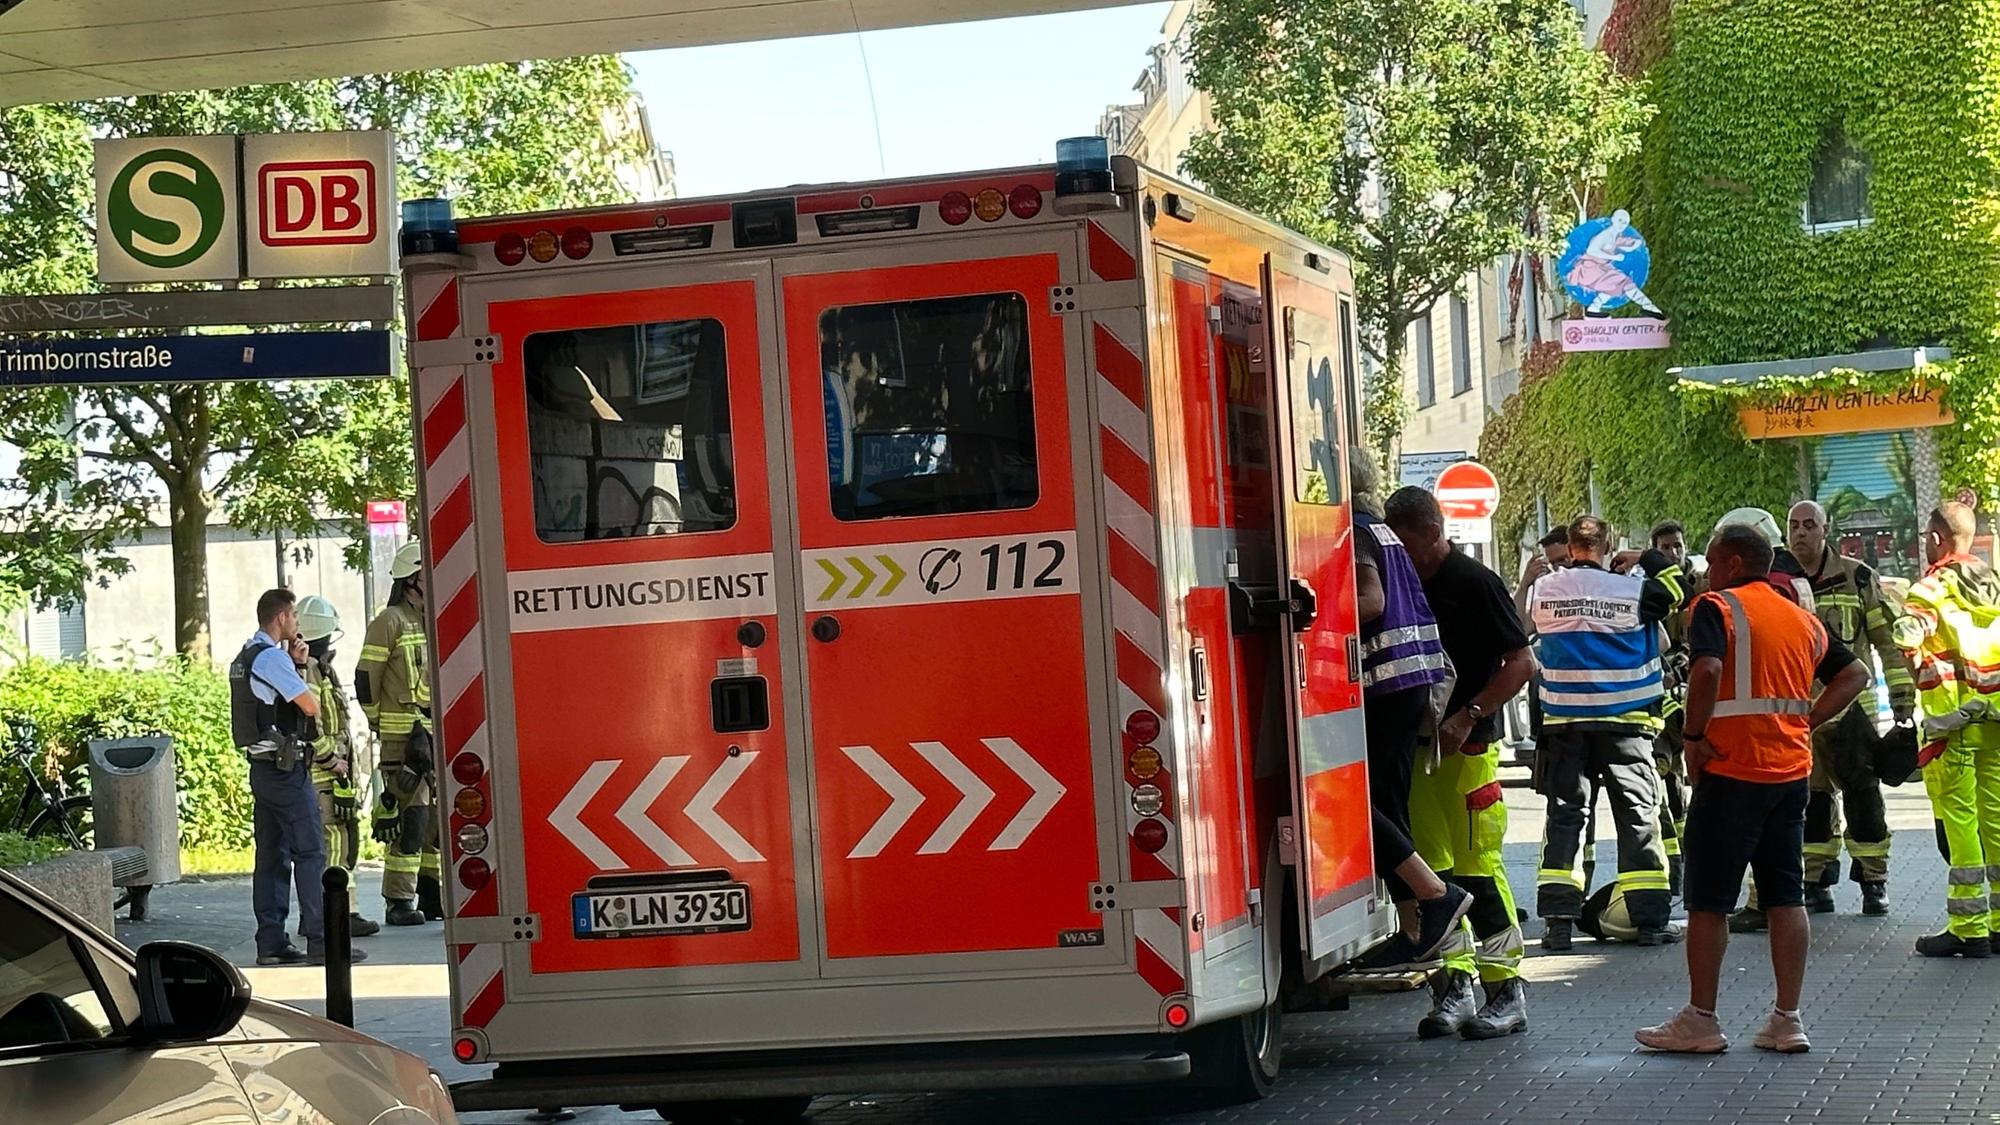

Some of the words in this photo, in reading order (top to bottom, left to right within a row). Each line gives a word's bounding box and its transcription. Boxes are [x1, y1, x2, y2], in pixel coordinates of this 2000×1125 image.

[128, 160, 203, 257] S
[274, 175, 362, 232] DB
[1622, 324, 1655, 335] CENTER
[980, 539, 1066, 592] 112
[513, 571, 769, 614] RETTUNGSDIENST
[580, 918, 587, 927] D
[593, 899, 612, 928] K
[630, 895, 669, 926] LN
[674, 891, 745, 924] 3930
[1064, 931, 1097, 943] WAS
